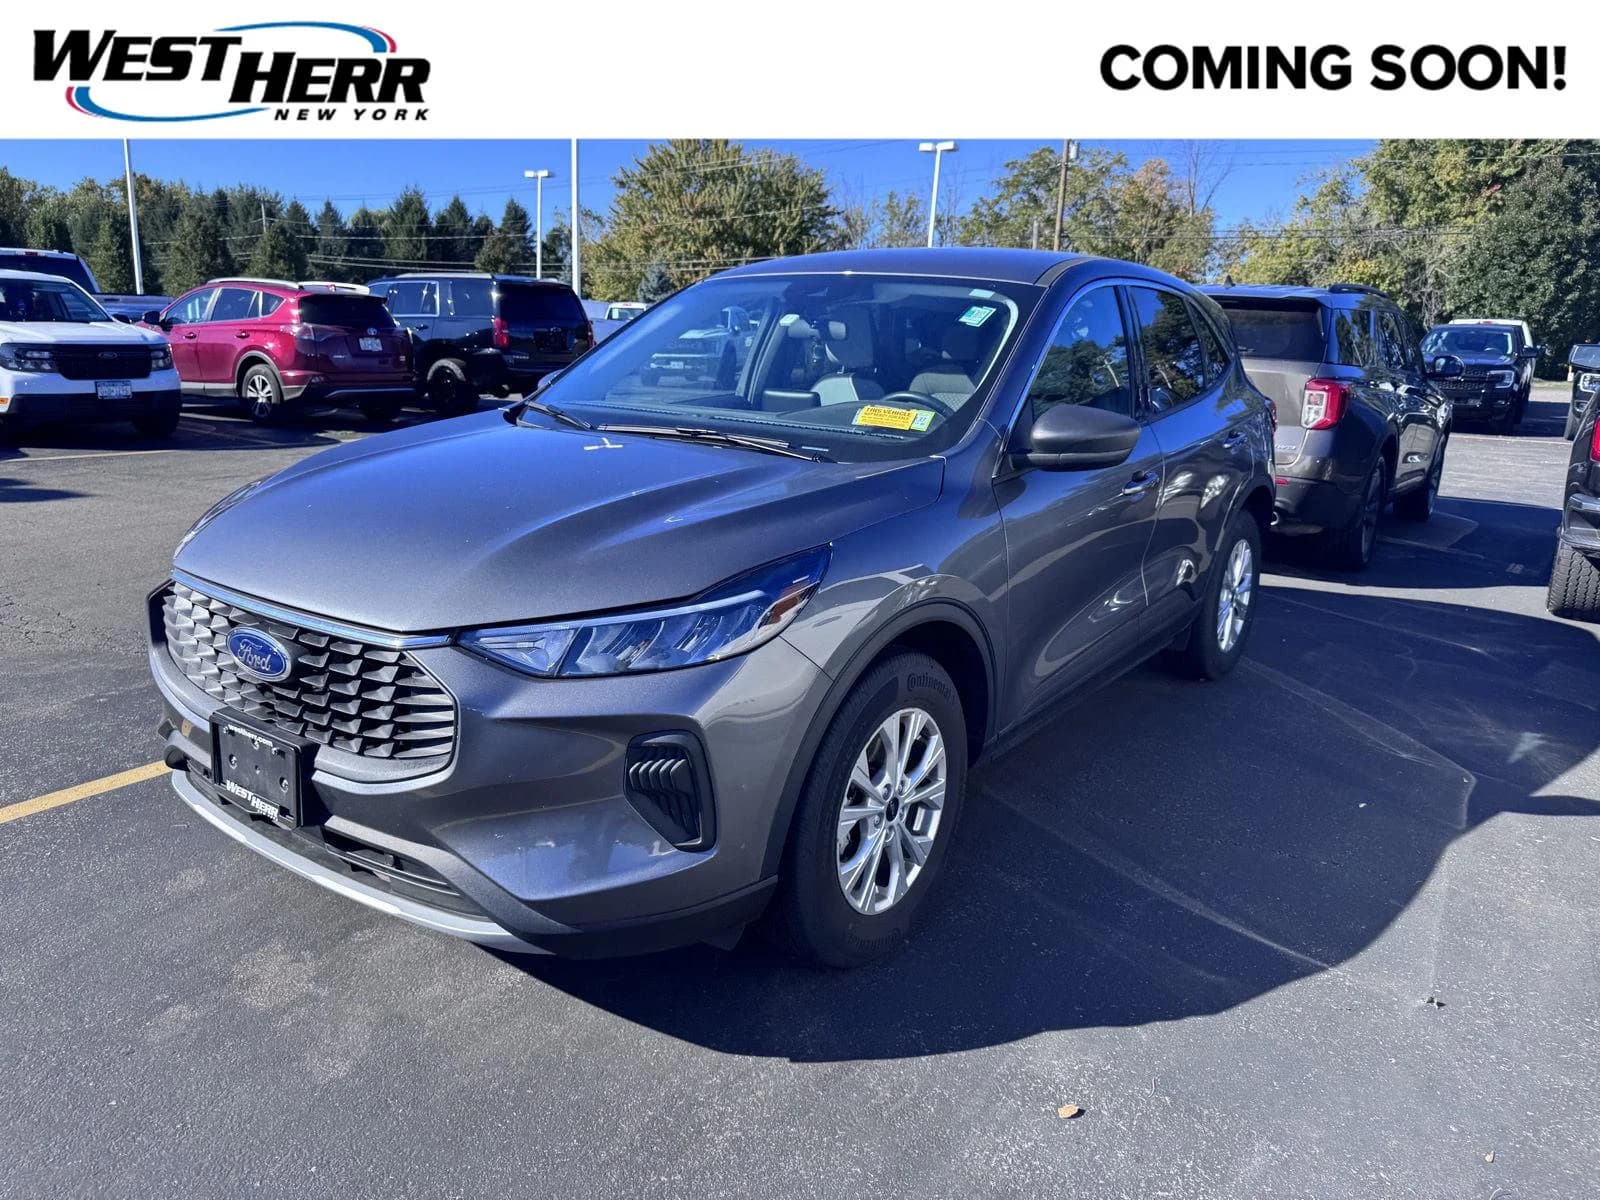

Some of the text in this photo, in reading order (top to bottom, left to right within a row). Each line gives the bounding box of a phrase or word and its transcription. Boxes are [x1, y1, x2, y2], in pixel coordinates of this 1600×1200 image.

[883, 408, 911, 416] VEHICLE
[238, 639, 272, 671] Ford
[226, 779, 254, 801] WEST
[251, 795, 279, 818] HERR
